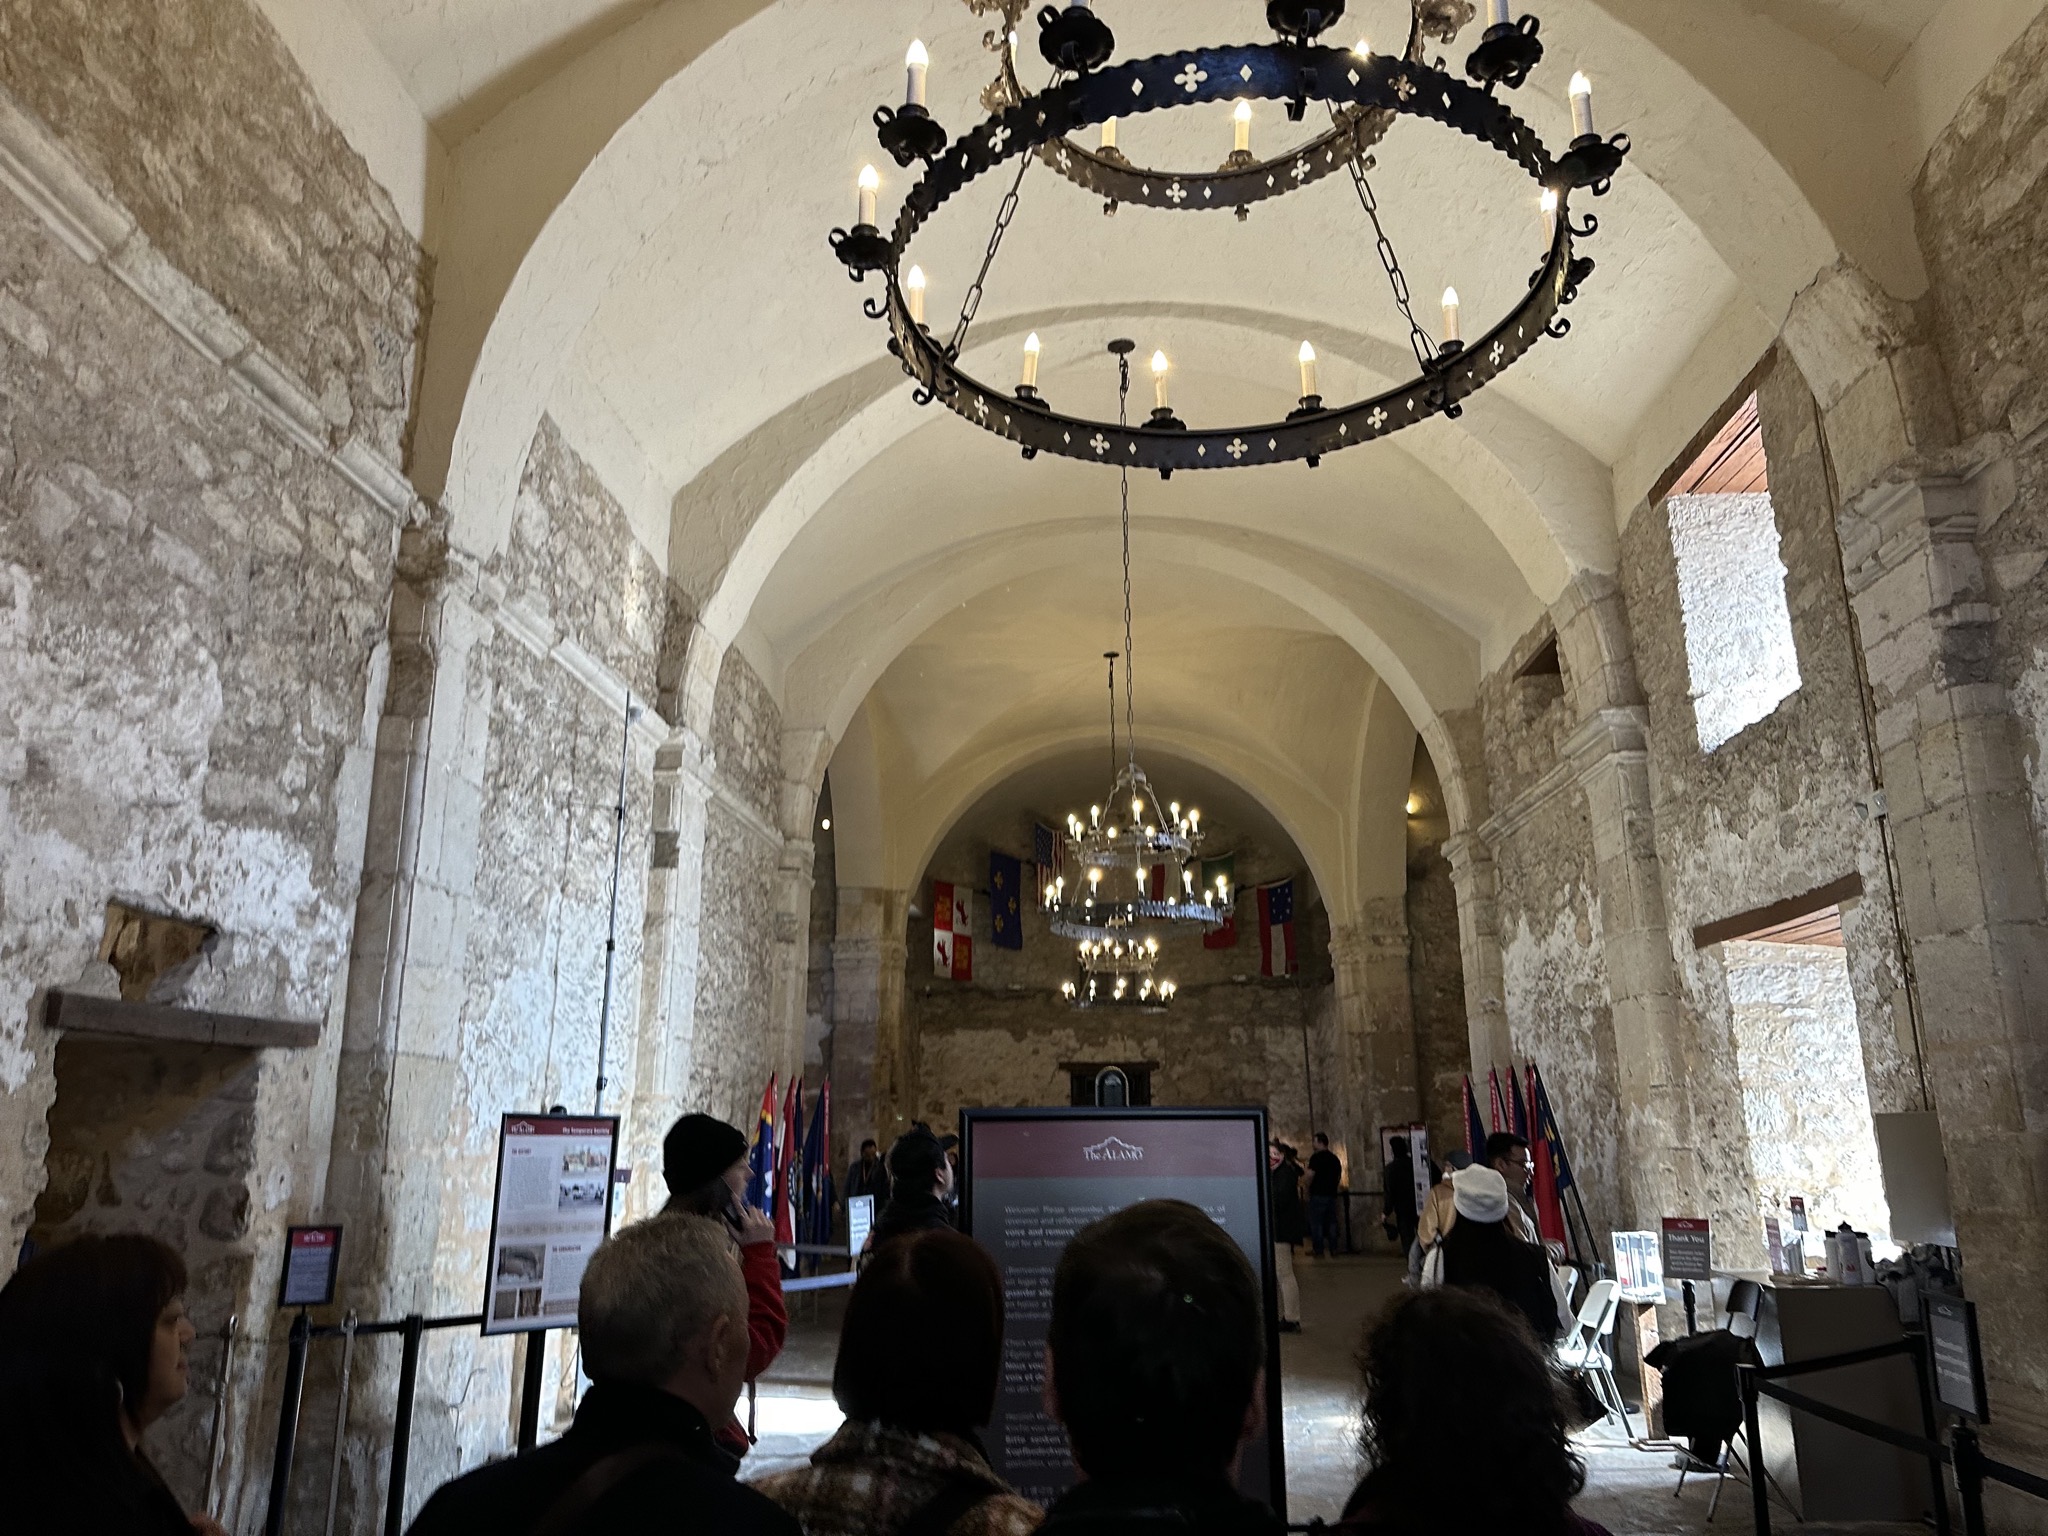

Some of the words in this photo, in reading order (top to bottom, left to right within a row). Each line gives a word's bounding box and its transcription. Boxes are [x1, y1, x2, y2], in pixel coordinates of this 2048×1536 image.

[1085, 1150, 1101, 1161] The
[1102, 1147, 1143, 1161] ALAMO
[1004, 1228, 1025, 1237] voice
[1027, 1228, 1043, 1237] and
[1045, 1228, 1075, 1237] remove
[1667, 1233, 1689, 1243] Thank
[1690, 1234, 1705, 1244] You
